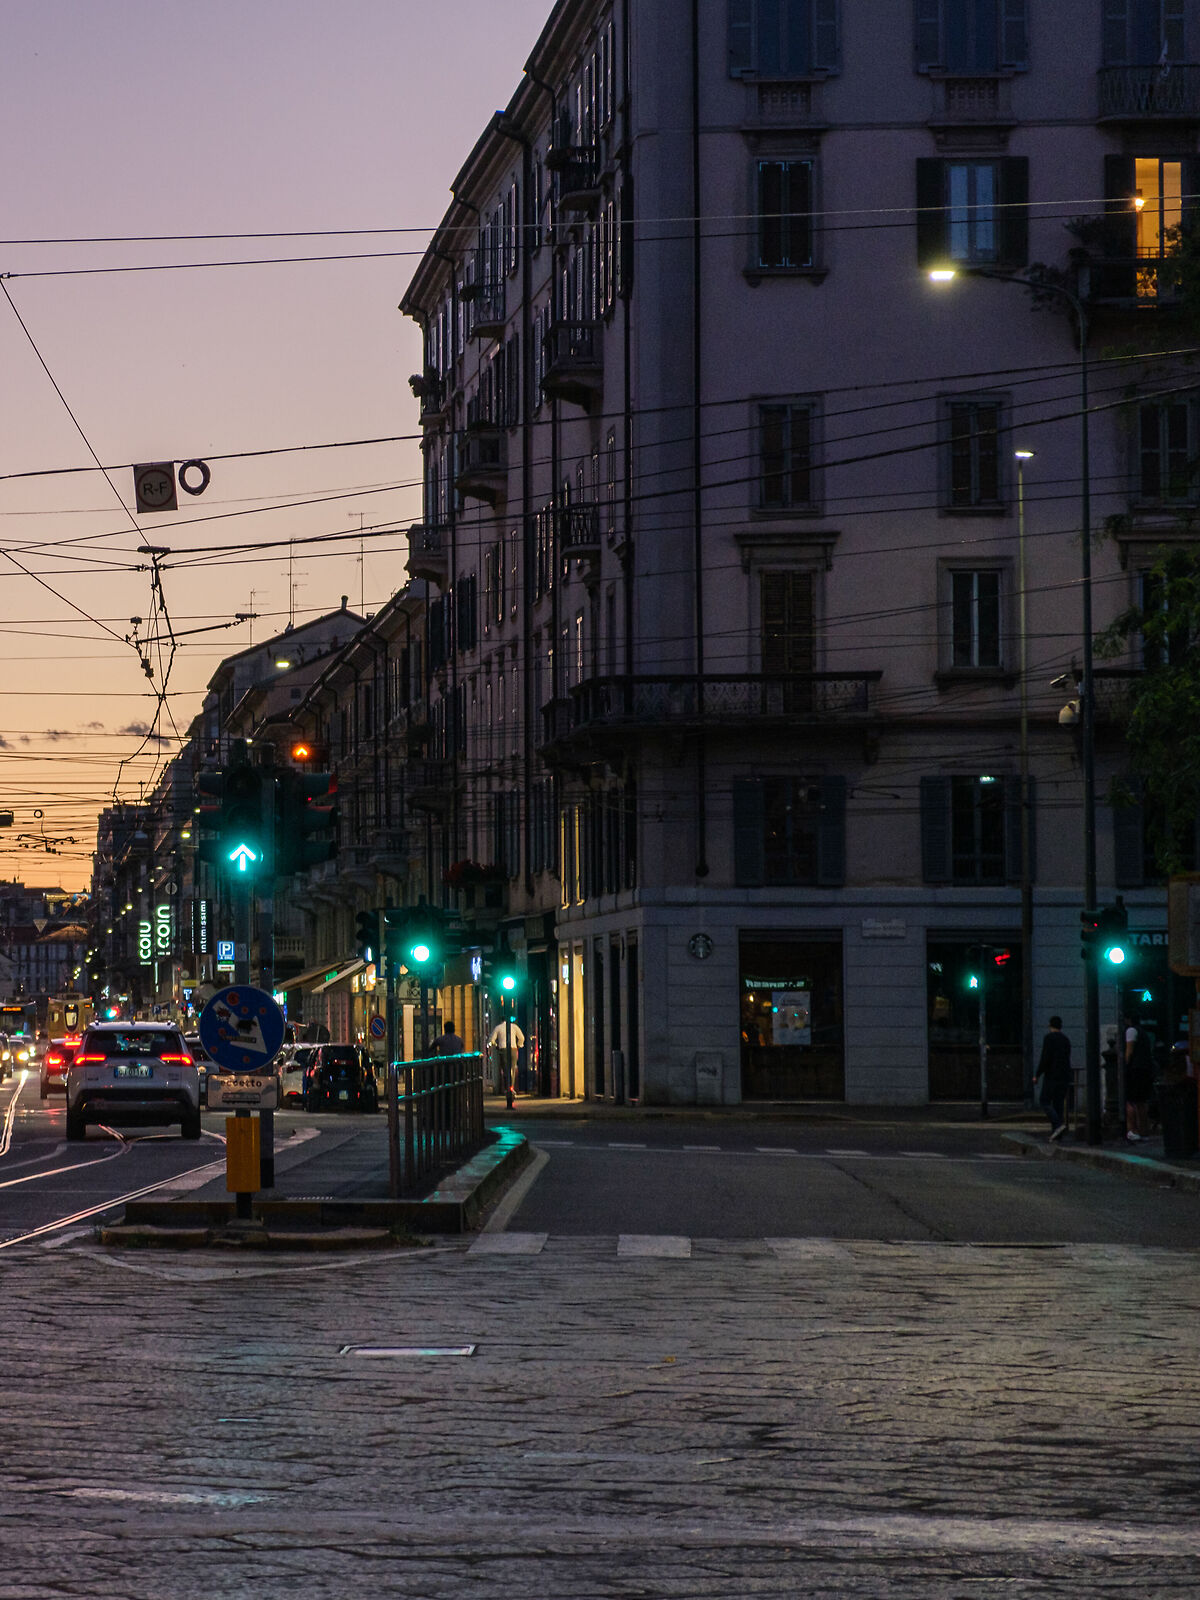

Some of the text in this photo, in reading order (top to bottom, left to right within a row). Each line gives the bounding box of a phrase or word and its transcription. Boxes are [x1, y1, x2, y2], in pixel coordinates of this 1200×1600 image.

[142, 480, 169, 496] R-F
[222, 943, 232, 955] P
[220, 1079, 263, 1088] eccetto
